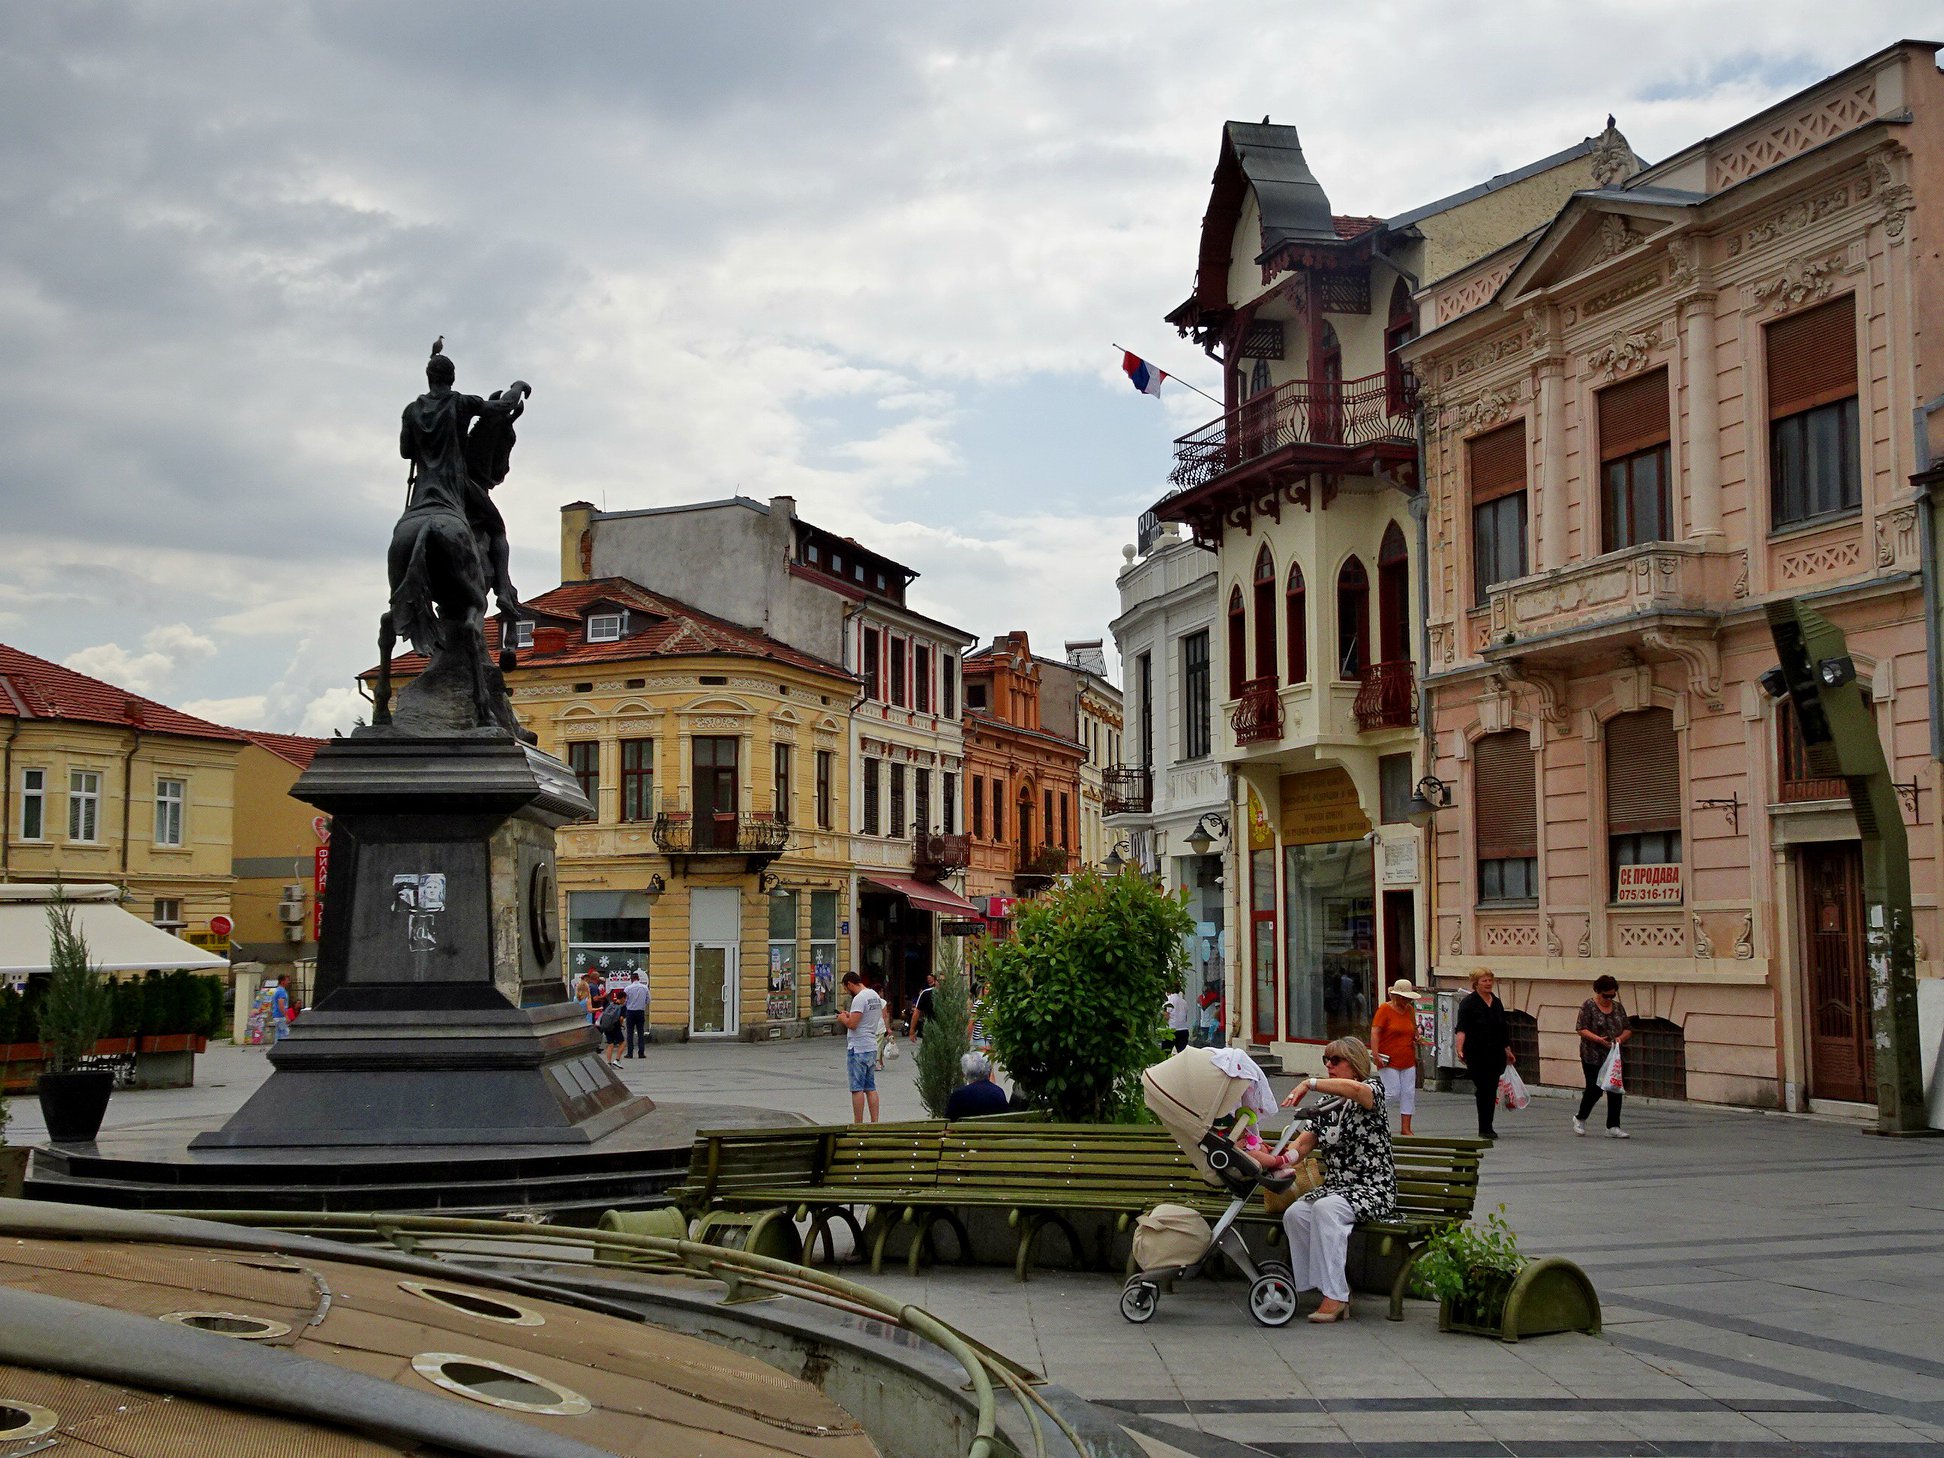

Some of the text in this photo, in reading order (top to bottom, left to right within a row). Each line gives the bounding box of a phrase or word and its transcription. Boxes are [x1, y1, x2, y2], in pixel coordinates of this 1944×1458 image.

[1620, 867, 1679, 886] СЕ ПРОДАВА
[1619, 888, 1680, 901] 075/316-171
